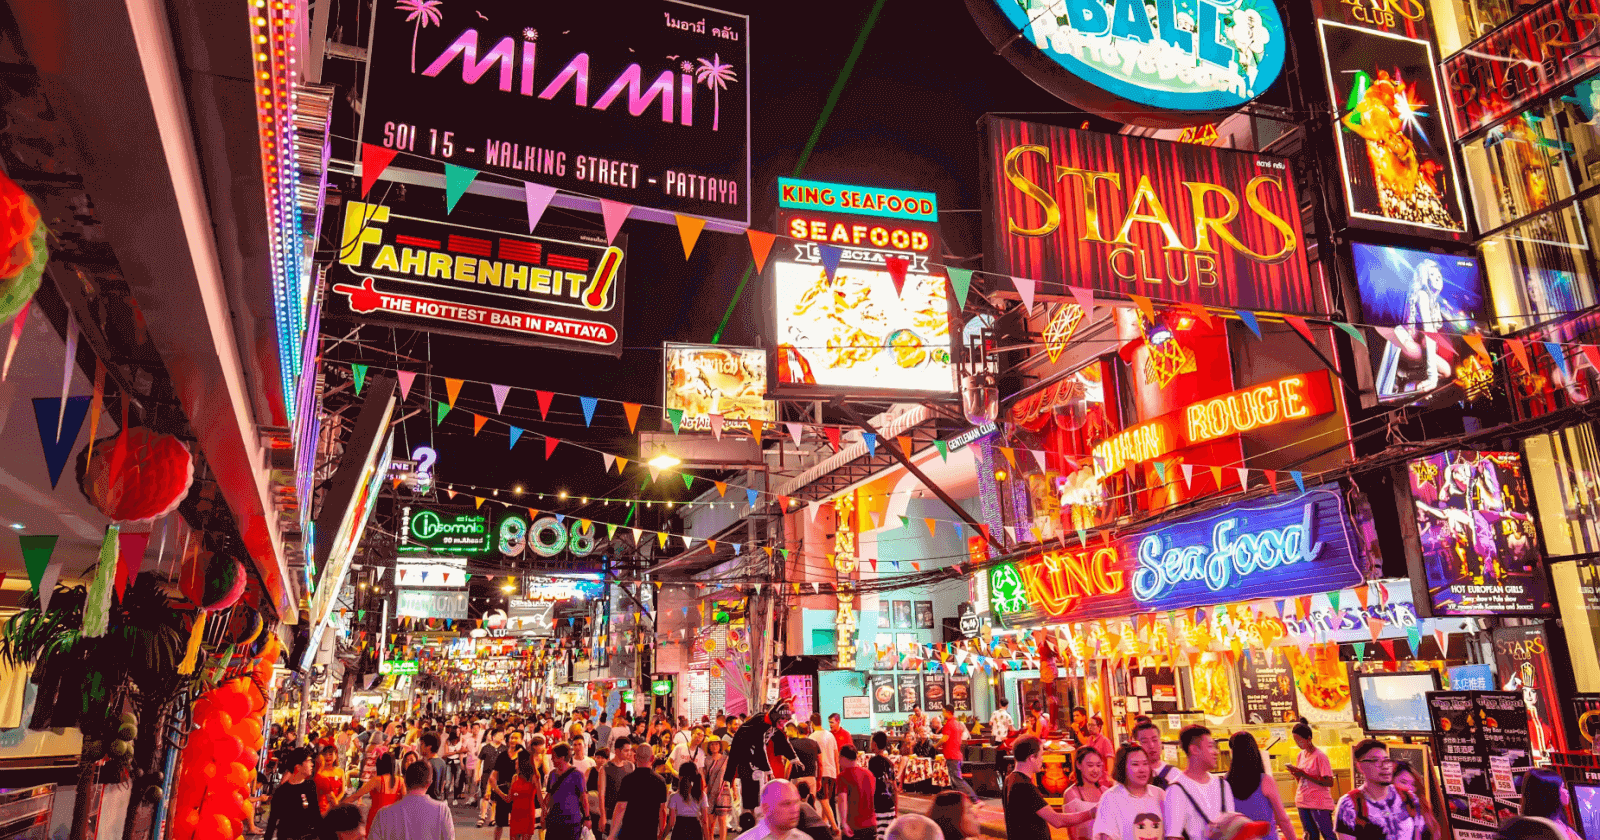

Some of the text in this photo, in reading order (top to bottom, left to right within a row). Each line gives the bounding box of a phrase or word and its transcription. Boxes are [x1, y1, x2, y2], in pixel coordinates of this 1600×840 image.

[712, 25, 739, 42] คลับ
[1352, 6, 1396, 28] CLUB
[384, 121, 415, 153] SOI
[430, 129, 455, 158] 15
[486, 138, 567, 177] WALKING
[576, 155, 639, 190] STREET
[666, 175, 738, 205] PATTAYA
[782, 184, 935, 216] KING SEAFOOD
[1004, 144, 1297, 265] STARS
[339, 200, 588, 300] FAHRENHEIT
[790, 218, 930, 251] SEAFOOD
[1109, 247, 1219, 288] CLUB
[380, 295, 608, 340] THE HOTTEST BAR IN PATTAYA
[1187, 377, 1308, 443] ROUGE
[947, 421, 997, 450] GENTLEMAN CLUB
[834, 492, 857, 669] KING CAFE
[1451, 585, 1524, 594] HOT EUROPEAN GIRLS
[1496, 637, 1546, 655] STARS
[1513, 652, 1532, 661] CLUB
